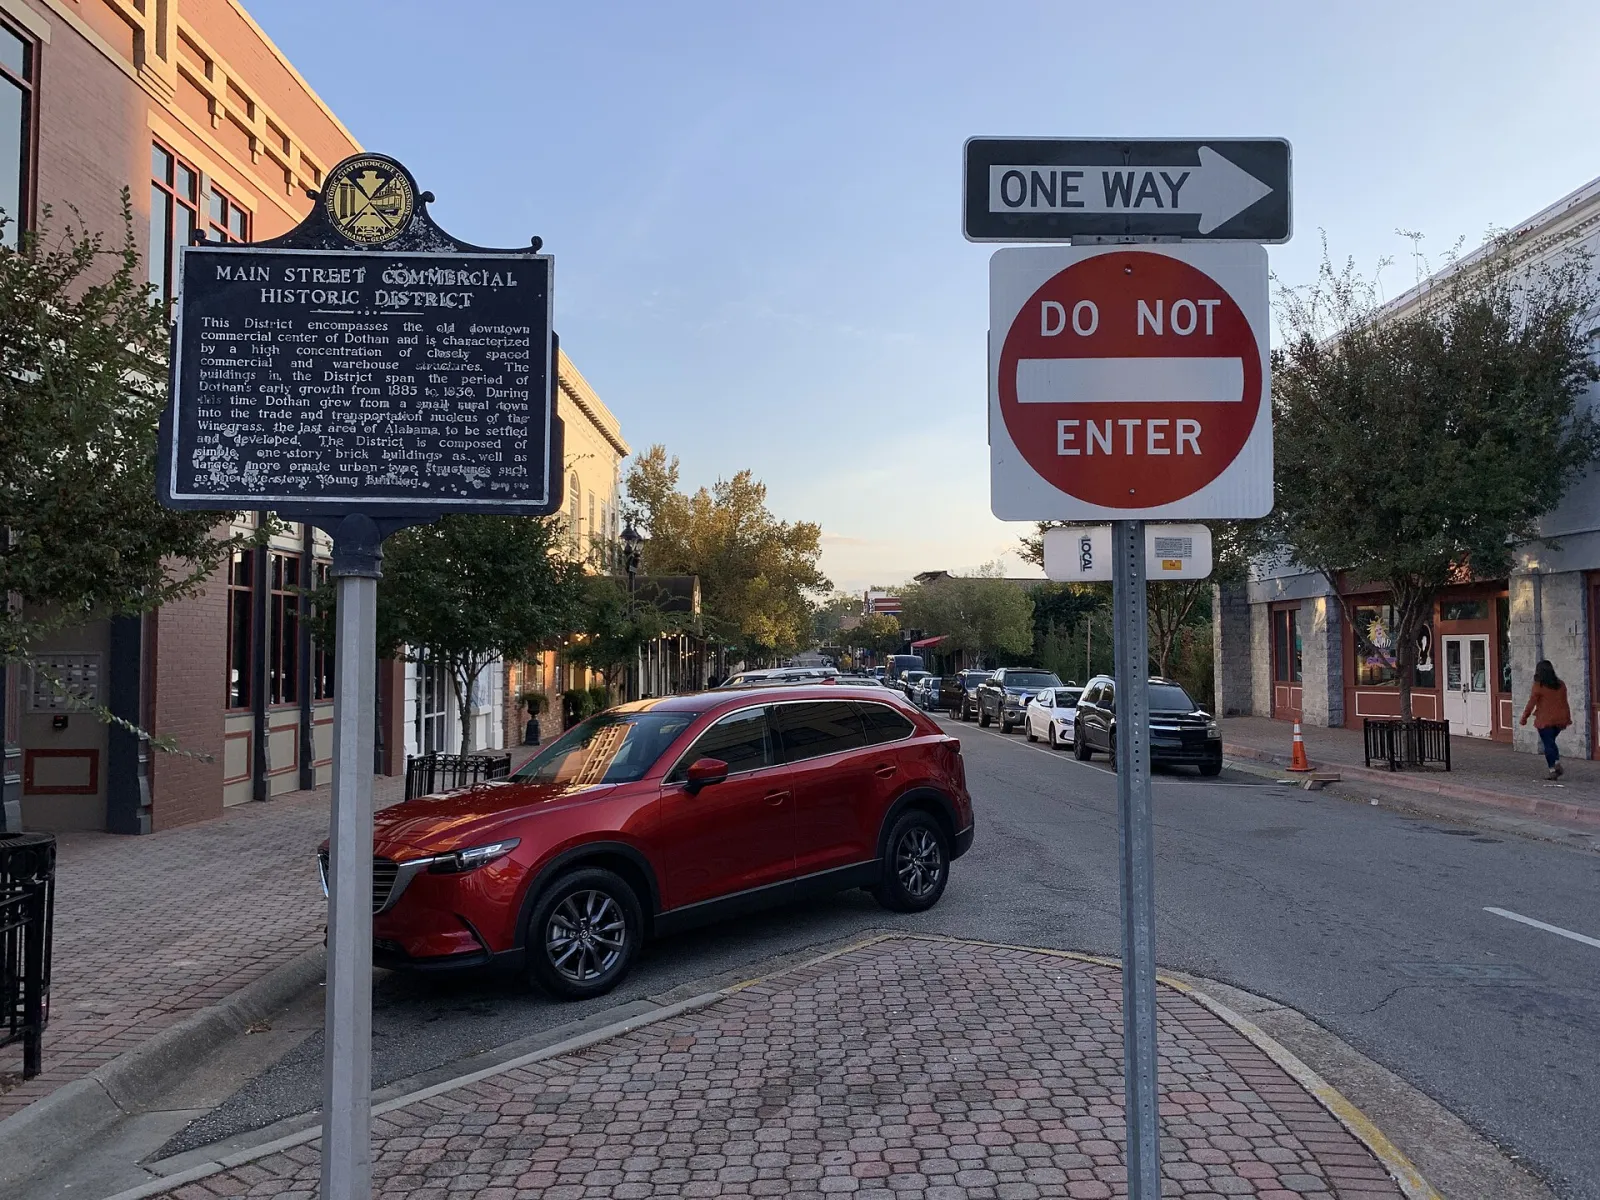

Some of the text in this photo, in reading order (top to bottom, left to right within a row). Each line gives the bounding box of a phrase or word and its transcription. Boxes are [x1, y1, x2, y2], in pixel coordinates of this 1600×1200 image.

[328, 180, 340, 212] HISTORIC
[1000, 170, 1191, 209] ONE WAY
[216, 266, 518, 287] MAIN STREET COMMERCIAL
[260, 288, 474, 308] HISTORIC DISTRICT
[201, 317, 530, 335] This District encompasses the old downtown
[1040, 299, 1221, 337] DO NOT
[201, 332, 530, 347] commercial center of Dothan and is characterized
[200, 343, 530, 360] by a high concentration of closely spaced
[200, 358, 272, 367] commercial
[291, 359, 313, 368] and
[333, 360, 399, 370] warehouse
[504, 362, 530, 372] The
[200, 370, 256, 382] buildings
[292, 371, 312, 381] the
[324, 371, 372, 382] District
[386, 374, 415, 386] span
[428, 374, 448, 383] the
[461, 375, 503, 386] period
[516, 375, 530, 385] of
[199, 381, 252, 392] Dothan's
[259, 384, 292, 394] early
[299, 384, 344, 396] growth
[351, 384, 381, 395] from
[388, 384, 418, 396] 1885
[486, 387, 528, 400] During
[198, 395, 222, 404] this
[230, 395, 257, 405] time
[265, 395, 310, 406] Dothan
[320, 398, 351, 409] grew
[360, 397, 390, 408] from
[416, 400, 449, 410] small
[458, 401, 489, 411] rural
[496, 402, 528, 411] town
[198, 407, 529, 423] into the trade and transportation nucleus of the
[274, 422, 294, 432] the
[299, 422, 322, 434] last
[328, 424, 356, 433] area
[364, 424, 377, 433] of
[445, 426, 458, 436] to
[465, 426, 480, 436] be
[486, 426, 528, 437] settled
[1057, 419, 1202, 456] ENTER
[197, 434, 528, 450] and developed. The District is composed of
[257, 449, 323, 460] one-story
[336, 449, 369, 460] brick
[382, 450, 441, 462] buildings
[478, 452, 502, 462] well
[514, 453, 527, 462] as
[248, 462, 280, 470] more
[290, 462, 330, 472] ornate
[425, 463, 491, 474] structures
[500, 465, 527, 476] such
[194, 474, 208, 482] as
[317, 474, 358, 487] Young
[1081, 538, 1092, 572] LOCAL
